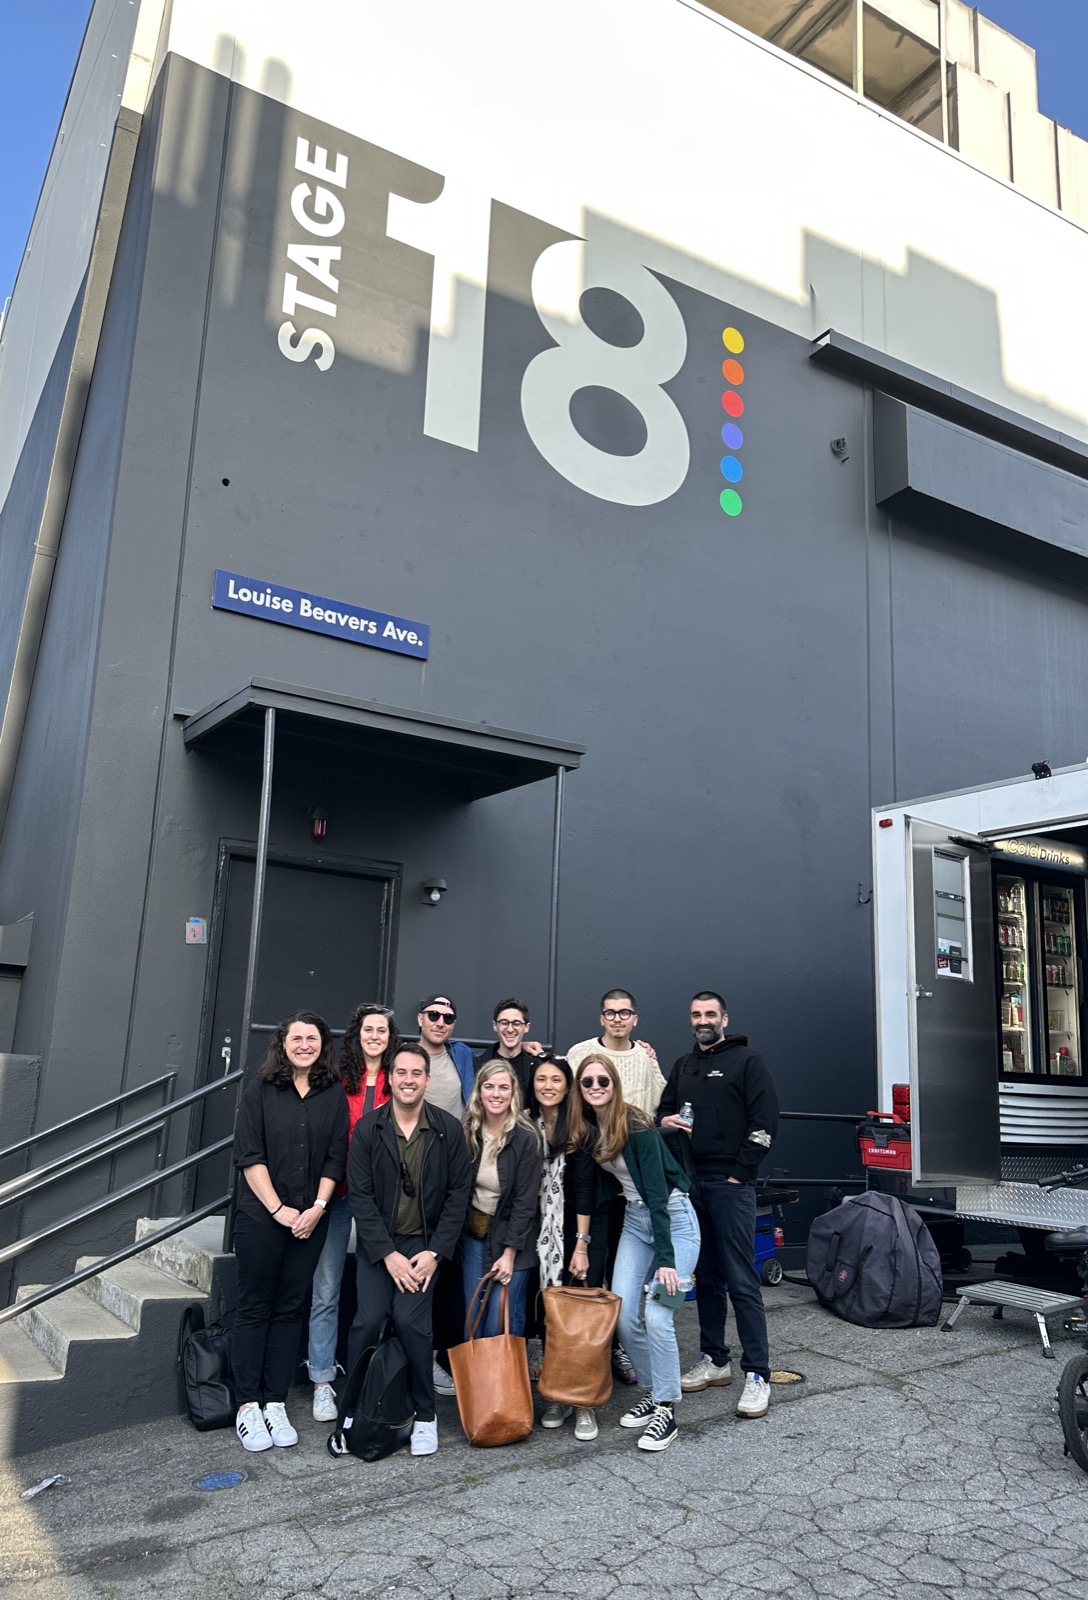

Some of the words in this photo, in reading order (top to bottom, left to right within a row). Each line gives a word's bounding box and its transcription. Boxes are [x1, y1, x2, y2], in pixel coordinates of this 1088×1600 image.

[277, 136, 350, 371] STAGE
[386, 175, 690, 506] 18
[228, 579, 294, 613] Louise
[300, 598, 378, 634] Beavers
[382, 620, 424, 647] Ave.
[1007, 839, 1040, 859] Cold
[1040, 848, 1070, 865] Drinks
